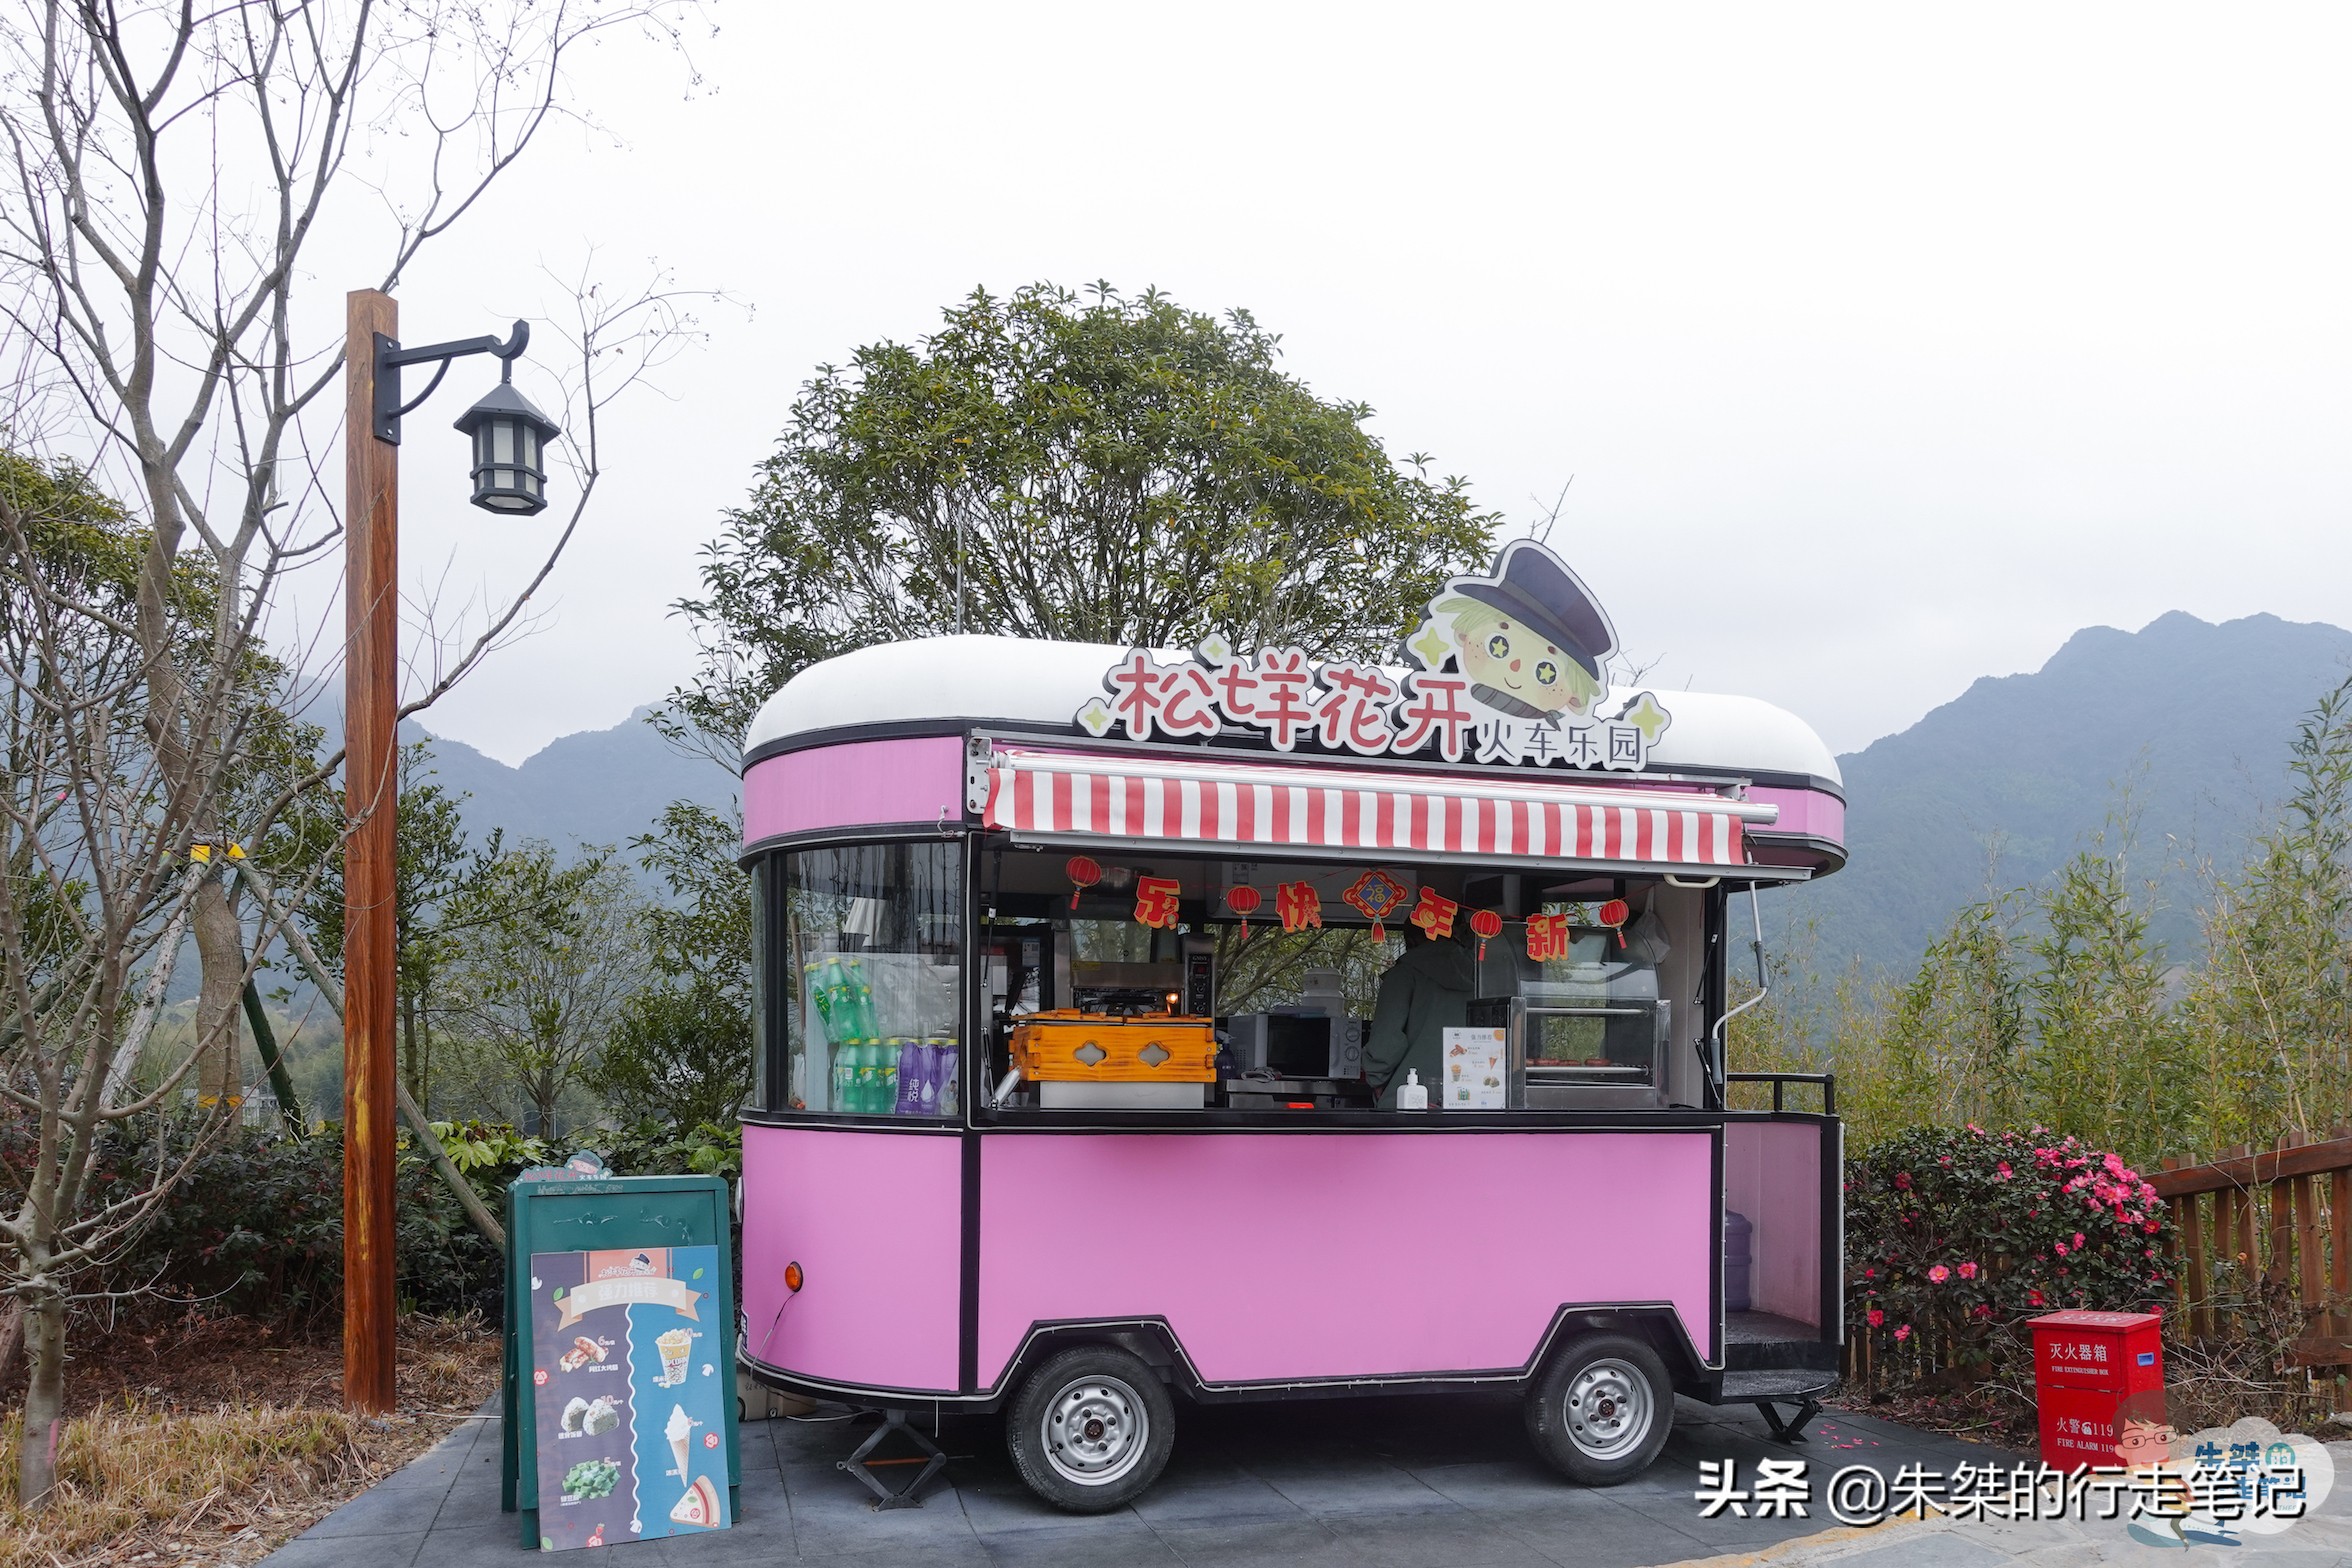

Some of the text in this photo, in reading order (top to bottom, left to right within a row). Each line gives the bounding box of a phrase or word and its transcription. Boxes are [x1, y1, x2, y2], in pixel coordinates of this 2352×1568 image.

[1481, 718, 1642, 766] 火车乐园
[1366, 883, 1387, 904] 福
[907, 1078, 920, 1102] 纯悦
[598, 1282, 658, 1300] 强力推荐
[2050, 1342, 2108, 1363] 灭火器箱
[2064, 1367, 2098, 1375] EXTINGUISHER
[2056, 1417, 2114, 1437] 火警 119
[2057, 1437, 2115, 1453] FIRE ALARM 119
